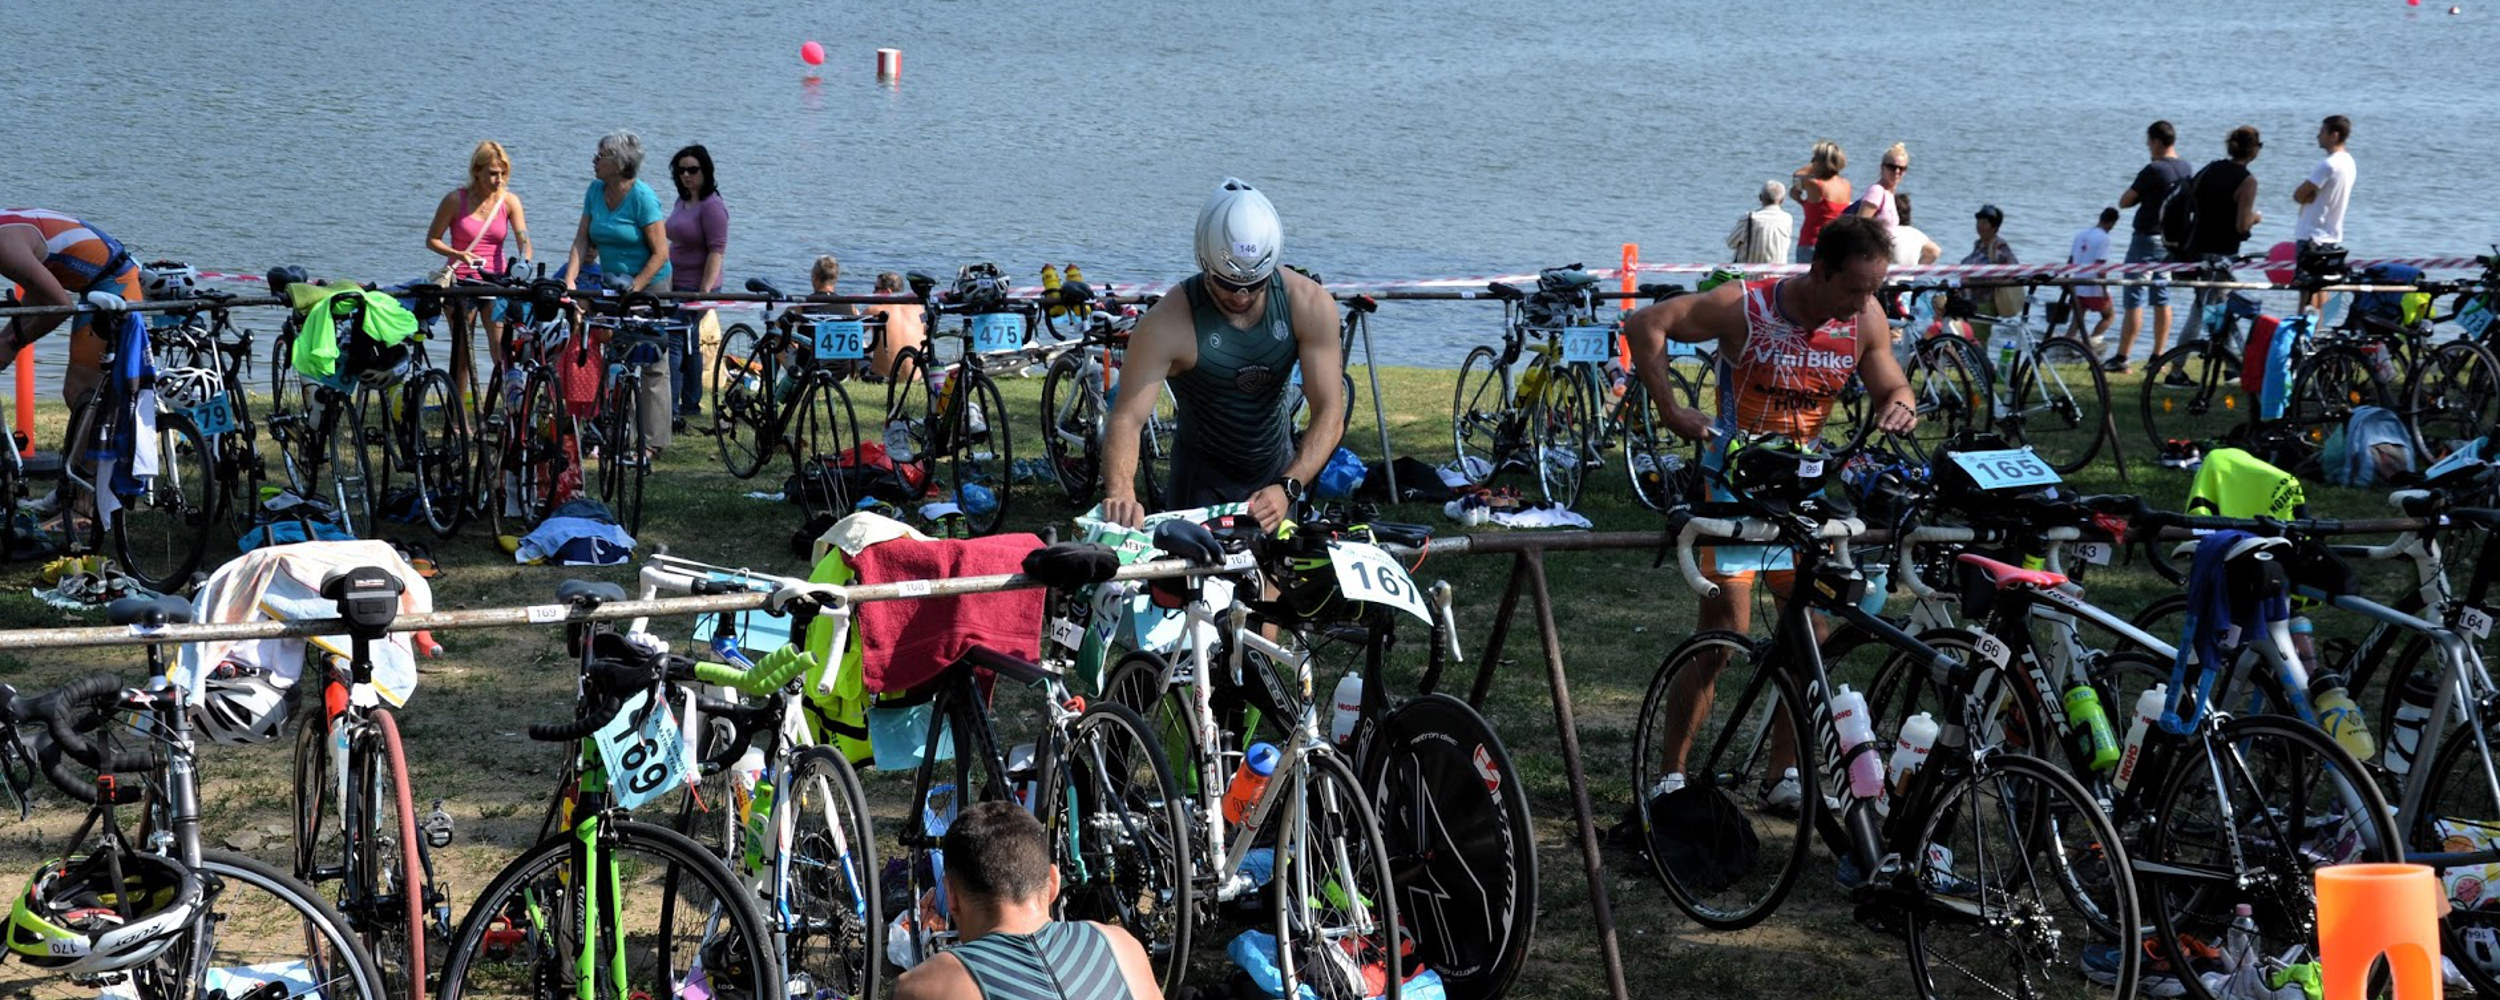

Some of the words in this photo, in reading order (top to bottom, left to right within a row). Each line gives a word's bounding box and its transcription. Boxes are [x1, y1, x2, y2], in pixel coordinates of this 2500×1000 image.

[821, 334, 859, 352] 476
[979, 326, 1017, 344] 475
[1568, 338, 1604, 355] 472
[1775, 397, 1817, 411] HUN
[196, 405, 226, 428] 79
[1976, 459, 2045, 480] 165
[2074, 542, 2097, 557] 143
[1231, 555, 1246, 564] 167
[1351, 561, 1415, 605] 167
[537, 608, 556, 617] 169
[2461, 612, 2483, 630] 164
[1051, 622, 1071, 641] 147
[1976, 636, 2000, 658] 166
[1248, 650, 1289, 712] FELT
[2021, 651, 2072, 738] TREK
[613, 714, 667, 794] 169
[1808, 680, 1854, 817] CANYON
[109, 922, 162, 950] RUDY
[52, 943, 77, 955] 170
